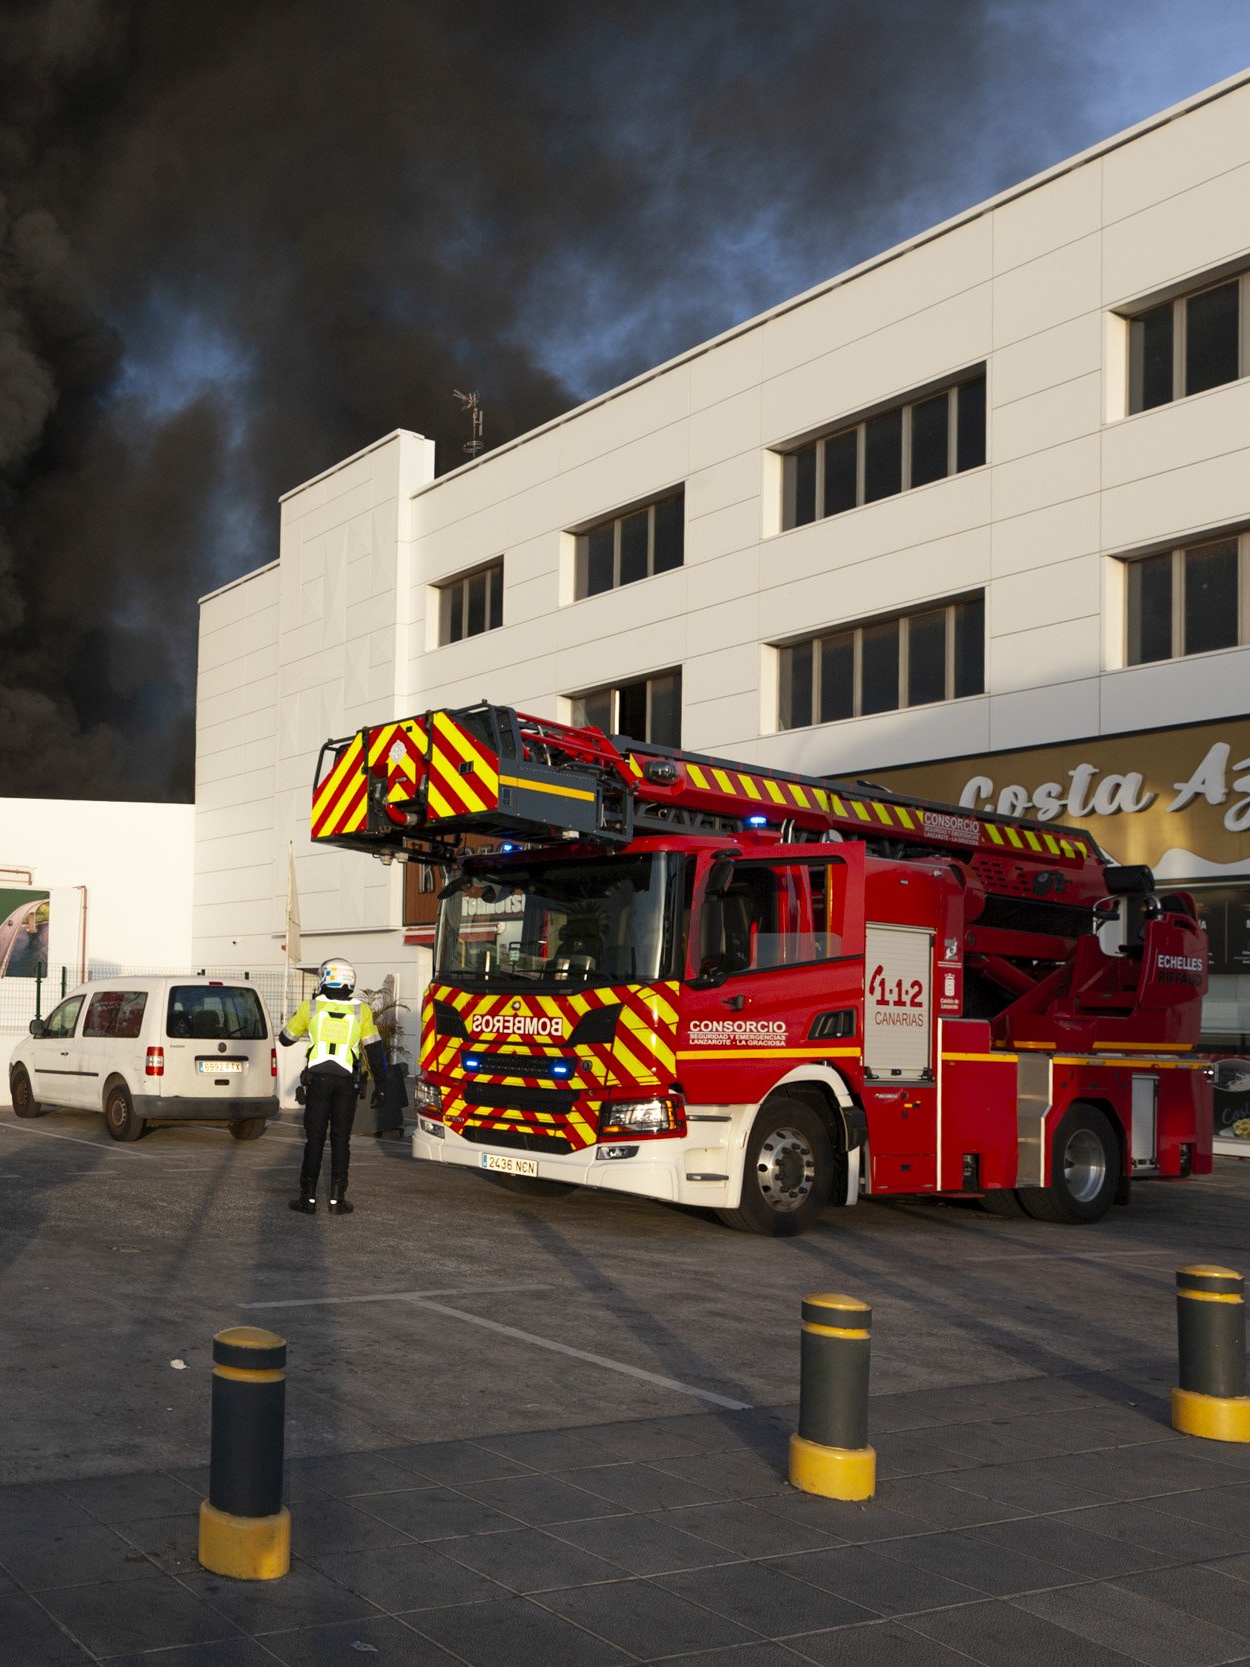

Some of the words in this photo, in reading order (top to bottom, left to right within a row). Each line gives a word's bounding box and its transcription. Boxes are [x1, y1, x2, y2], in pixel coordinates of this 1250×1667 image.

[958, 763, 1157, 822] Costa
[924, 812, 980, 832] CONSORCIO
[1158, 954, 1203, 971] ECHELLES
[1158, 971, 1202, 986] RIFFAUD
[690, 1020, 786, 1033] CONSORCIO
[874, 1011, 924, 1028] CANARIAS
[489, 1154, 513, 1171] 2436
[515, 1160, 535, 1174] NCN
